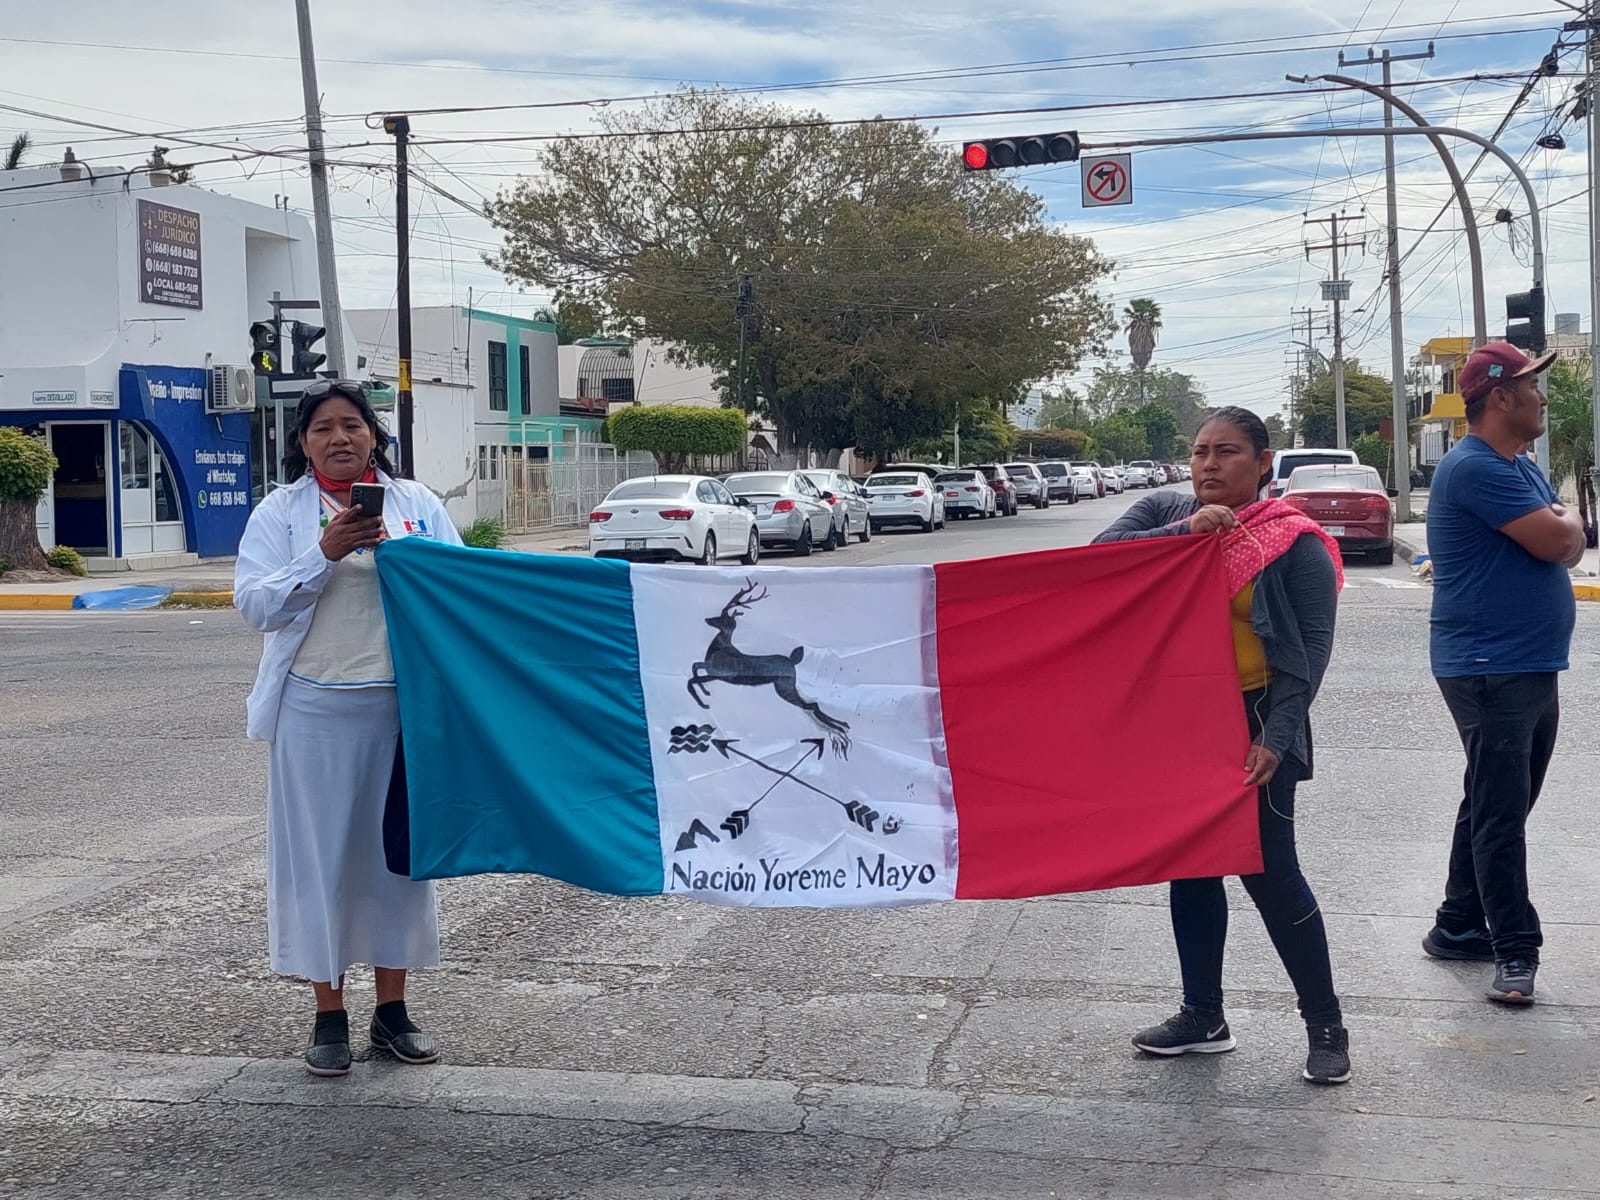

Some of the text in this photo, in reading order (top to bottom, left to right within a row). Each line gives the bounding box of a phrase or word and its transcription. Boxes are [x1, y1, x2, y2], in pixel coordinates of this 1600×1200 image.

[158, 209, 198, 230] DESPACHO
[161, 226, 196, 244] JURÍDICO
[152, 240, 169, 257] (668)
[170, 245, 182, 257] 688
[153, 259, 198, 278] (668) 183 7728
[153, 277, 174, 290] LOCAL
[227, 450, 246, 467] trabajos
[210, 491, 221, 505] 668
[670, 853, 936, 893] Nación Yoreme Mayo
